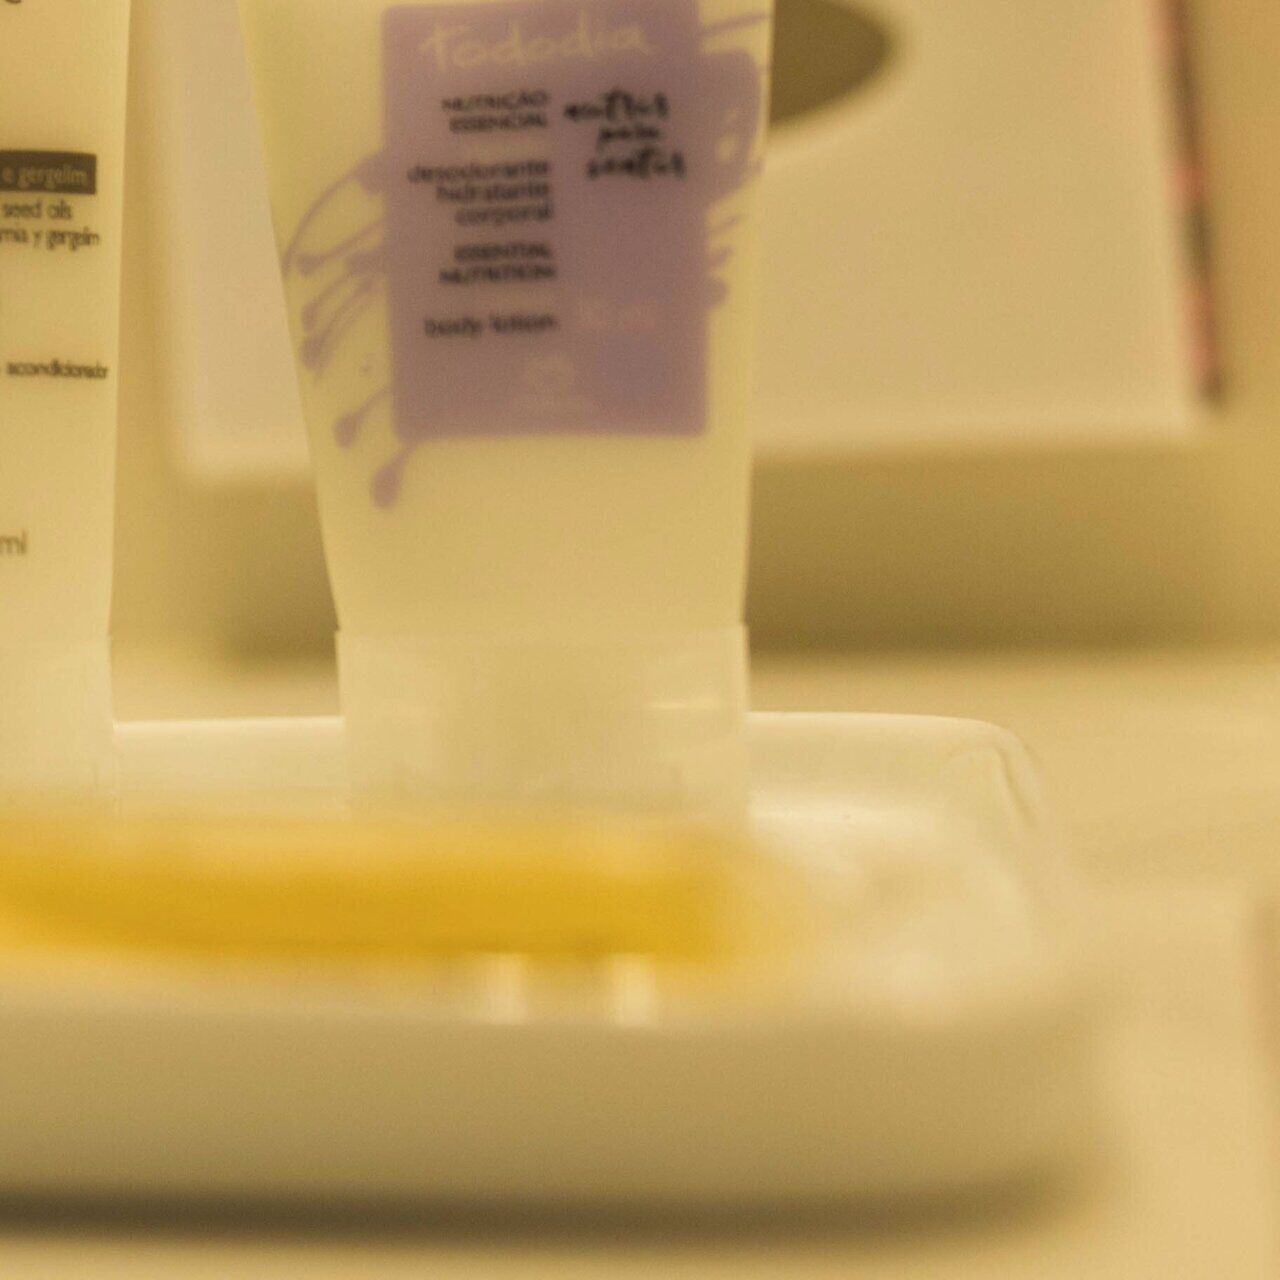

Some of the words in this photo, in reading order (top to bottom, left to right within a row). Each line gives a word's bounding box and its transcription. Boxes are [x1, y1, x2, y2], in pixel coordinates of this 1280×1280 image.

[2, 168, 13, 182] e
[18, 163, 87, 190] gergelim
[2, 199, 41, 219] seed
[47, 199, 72, 219] oils
[33, 231, 42, 247] y
